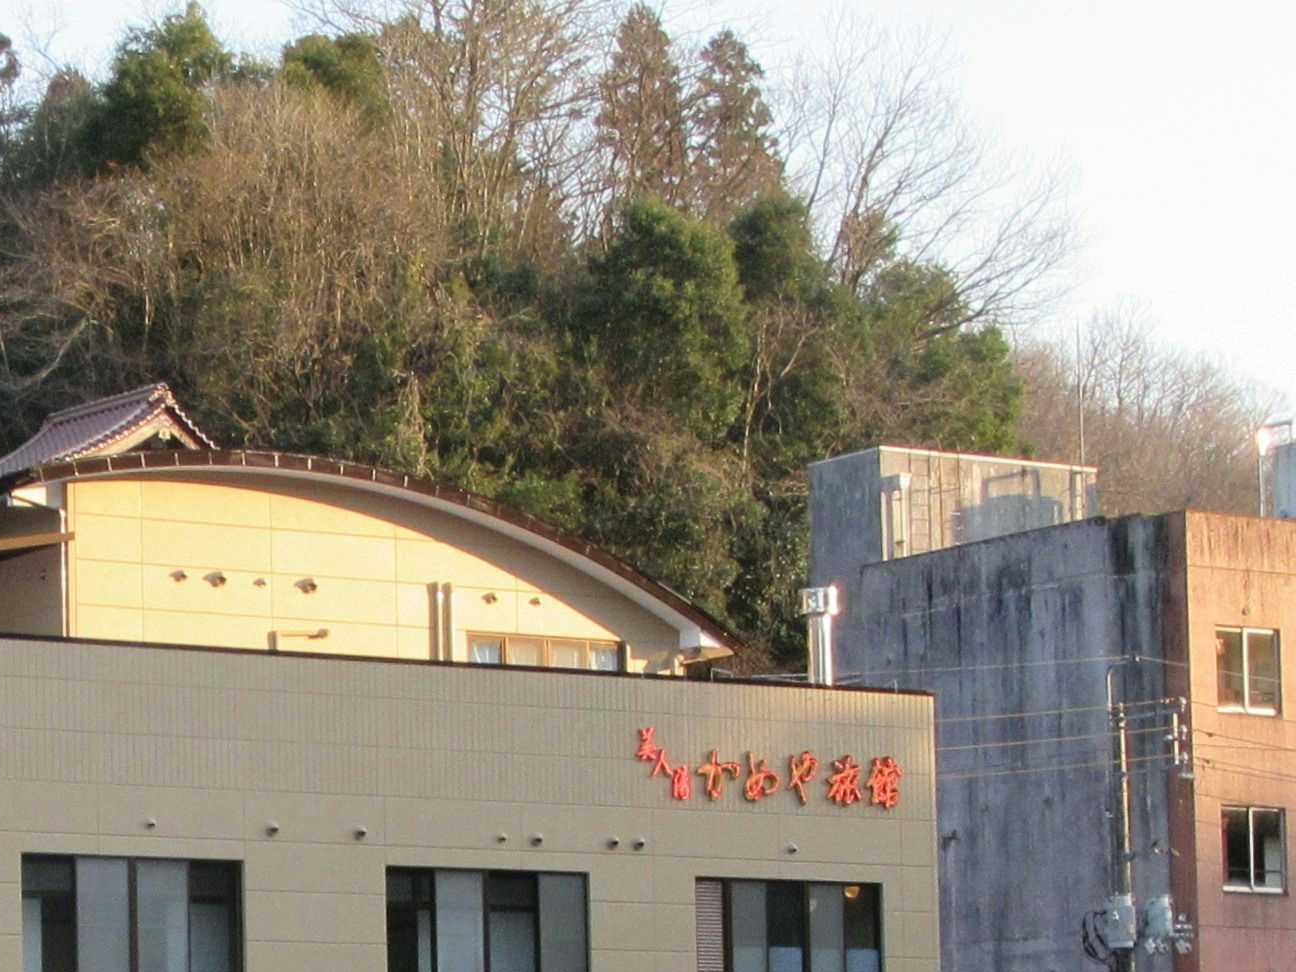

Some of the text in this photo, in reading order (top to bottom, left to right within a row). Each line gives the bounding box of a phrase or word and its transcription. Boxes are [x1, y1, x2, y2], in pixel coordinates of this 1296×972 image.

[699, 749, 902, 808] かめや旅館
